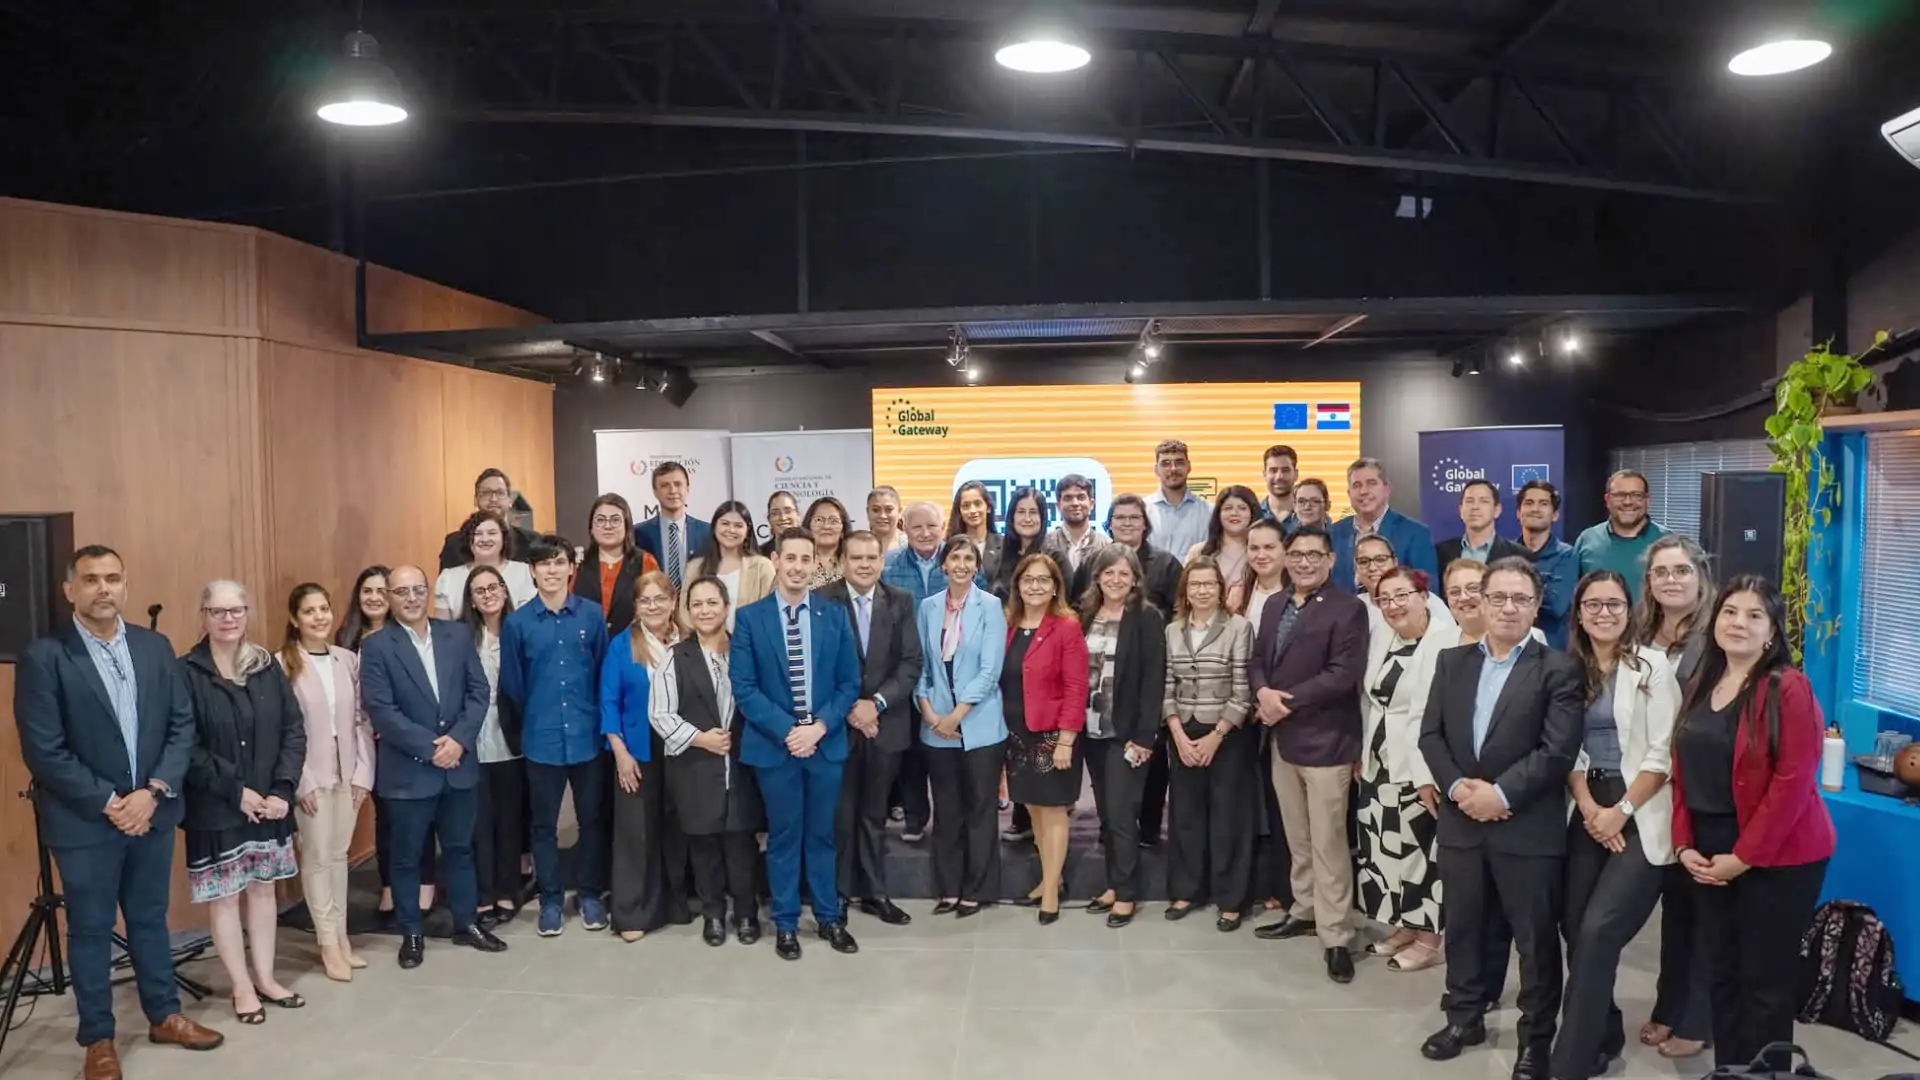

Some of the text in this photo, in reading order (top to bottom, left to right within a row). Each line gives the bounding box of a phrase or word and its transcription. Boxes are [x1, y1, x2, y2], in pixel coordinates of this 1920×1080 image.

[898, 409, 934, 421] Global
[898, 424, 949, 438] Gateway
[1445, 468, 1485, 480] Global
[774, 482, 812, 490] CIENCIA
